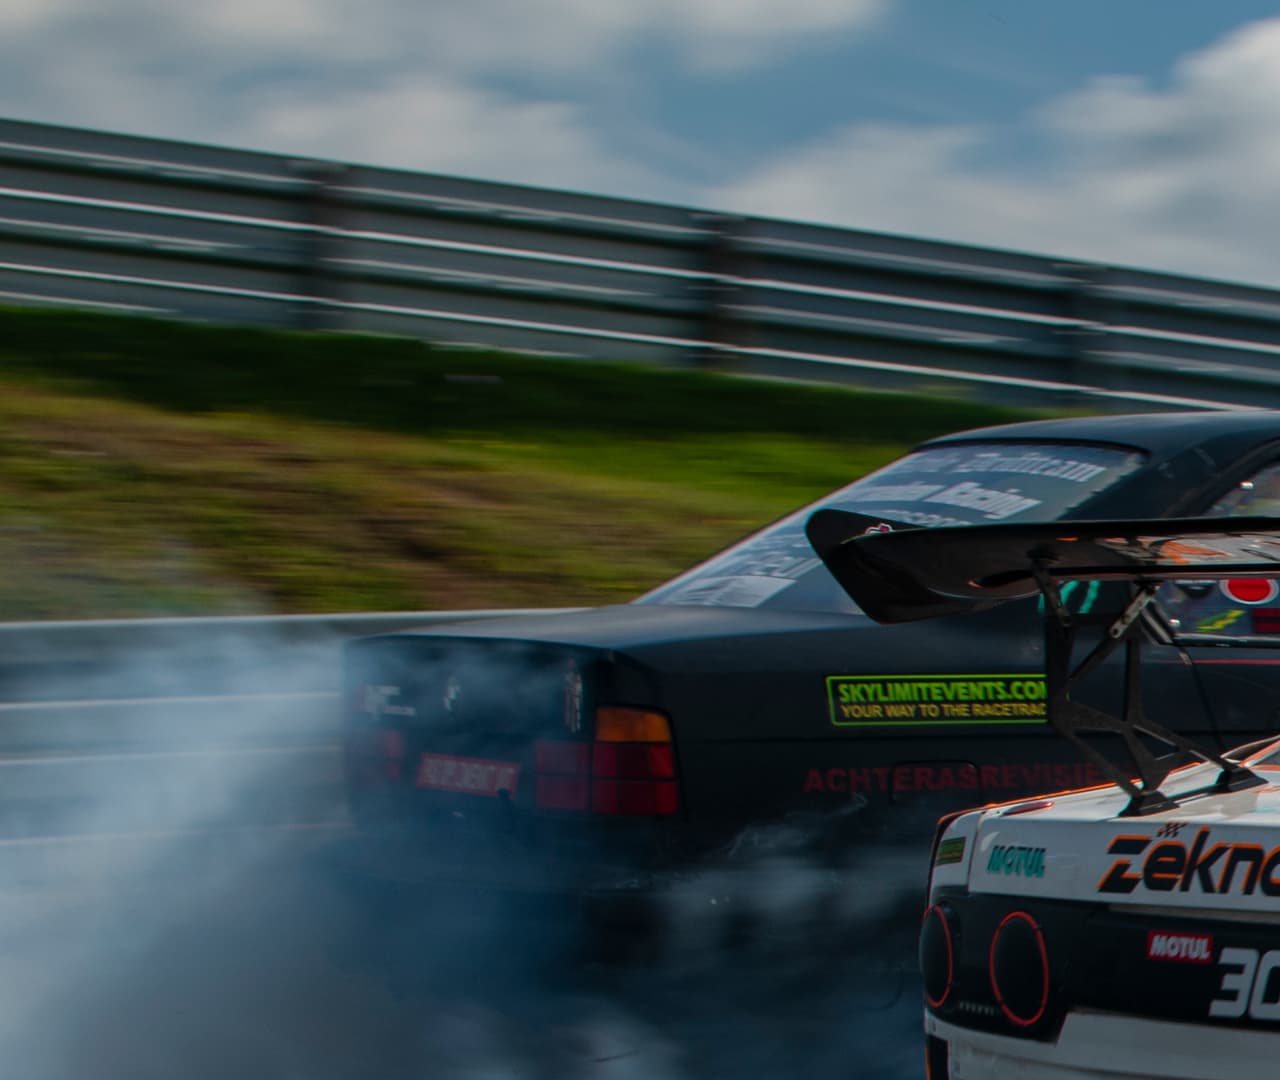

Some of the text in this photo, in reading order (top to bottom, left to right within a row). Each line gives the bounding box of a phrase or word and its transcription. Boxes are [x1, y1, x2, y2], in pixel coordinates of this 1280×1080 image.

[840, 703, 883, 719] YOUR
[886, 703, 915, 718] WAY
[920, 703, 939, 717] TO
[941, 702, 970, 717] THE
[987, 845, 1047, 878] MOTUL
[1149, 934, 1211, 959] MOTUL
